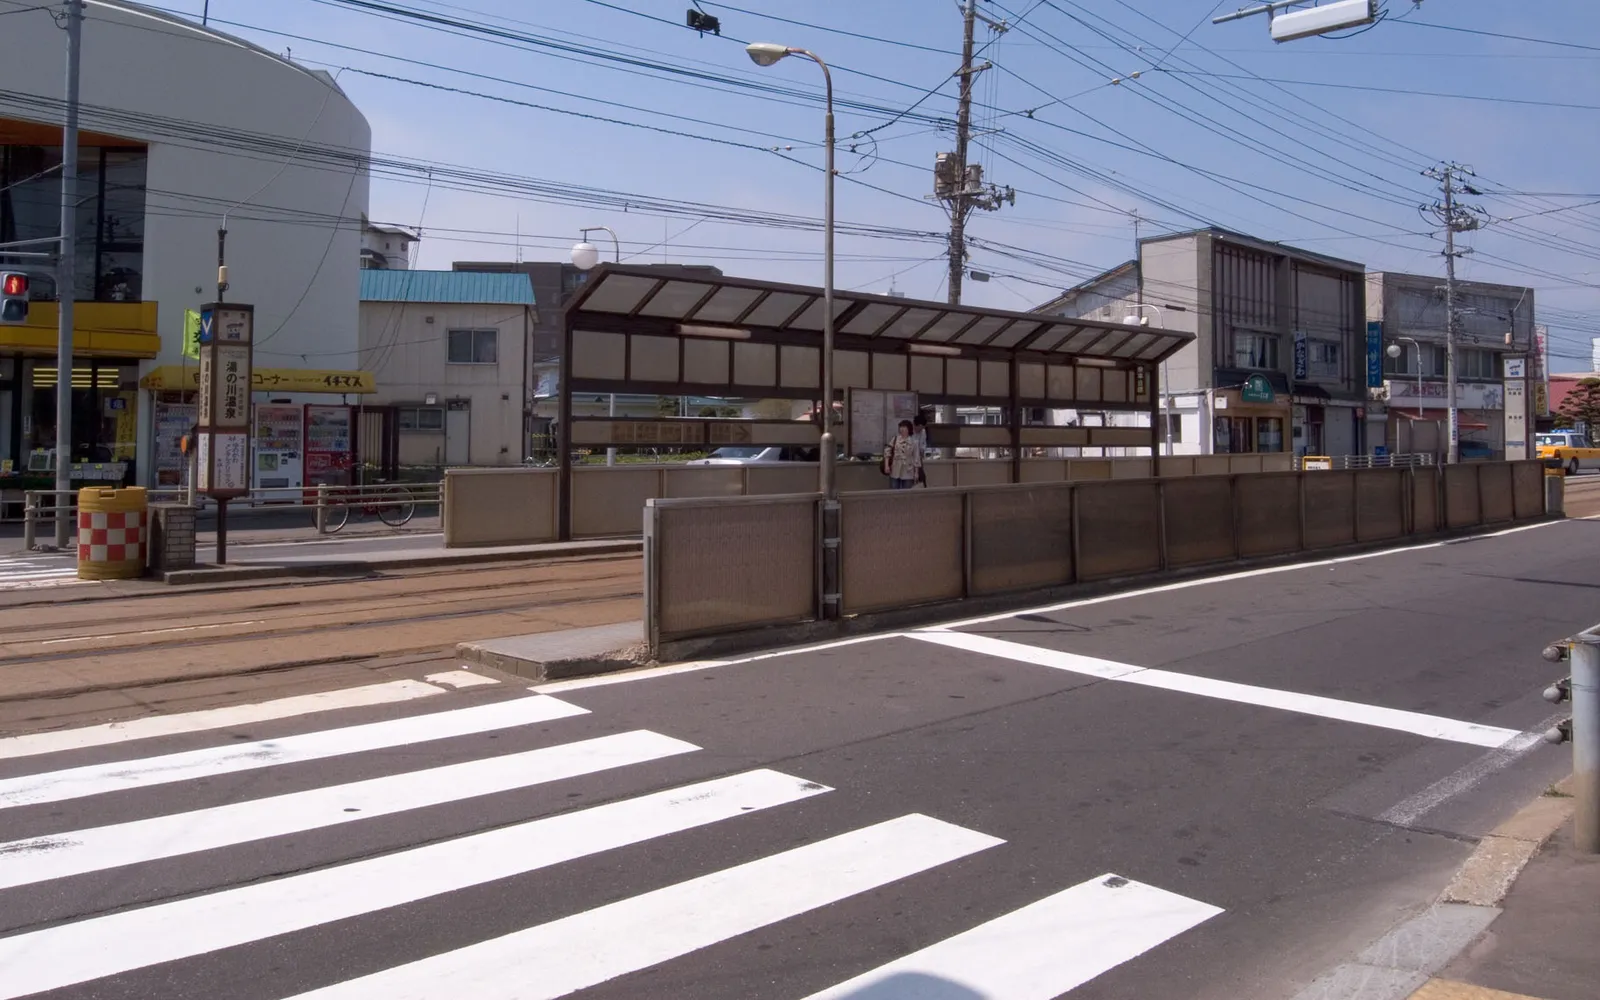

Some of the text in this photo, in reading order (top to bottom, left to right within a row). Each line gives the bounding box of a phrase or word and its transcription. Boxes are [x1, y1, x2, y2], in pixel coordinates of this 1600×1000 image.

[224, 361, 238, 419] 湯の川温泉
[323, 375, 364, 388] イチマス
